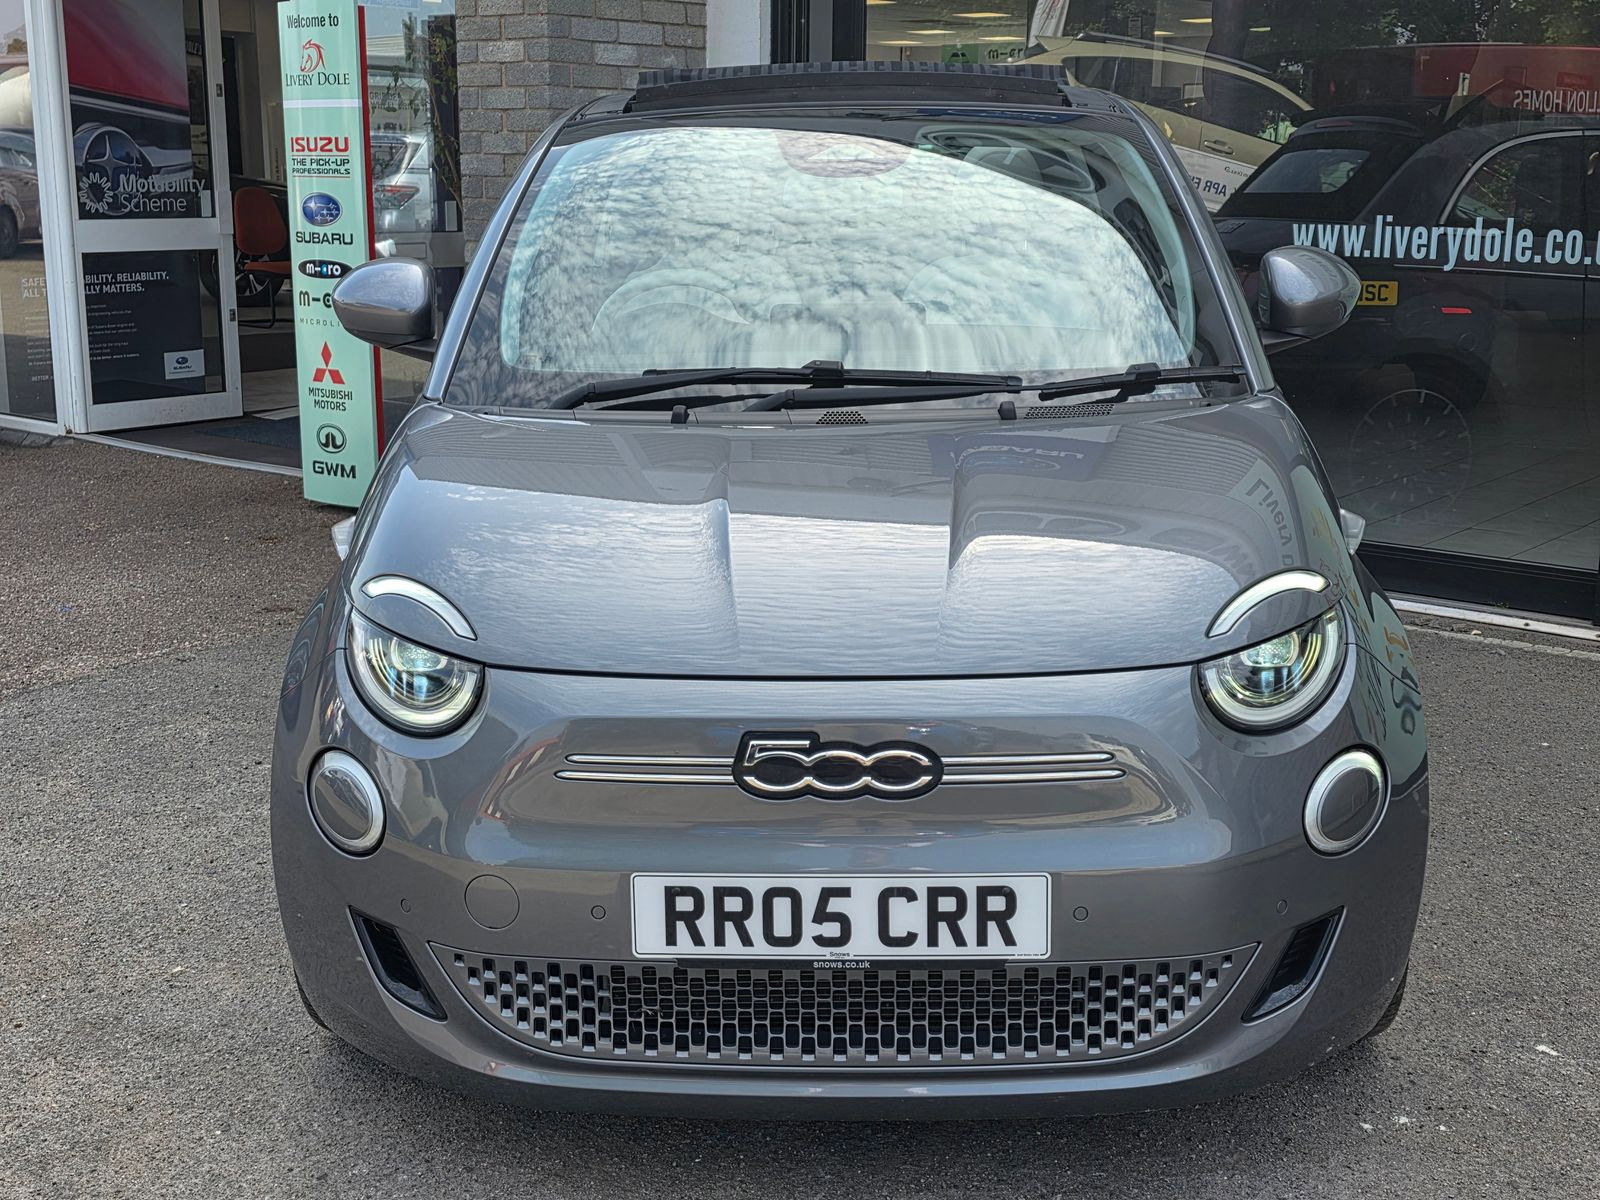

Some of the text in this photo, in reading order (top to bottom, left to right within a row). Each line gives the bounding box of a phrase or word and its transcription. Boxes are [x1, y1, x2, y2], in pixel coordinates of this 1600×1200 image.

[286, 13, 339, 28] Welcome to
[988, 48, 1023, 59] m-cr
[285, 72, 350, 87] LIVERY DOLE
[290, 136, 350, 153] ISUZU
[291, 158, 350, 167] THE PICK-UP
[291, 167, 351, 175] PROFESSIONALS
[120, 173, 206, 197] Motability
[121, 194, 187, 212] Scheme
[295, 231, 354, 245] SUBARU
[22, 271, 170, 287] SAFE BILITY. RELIABILITY.
[23, 288, 41, 298] ALL
[84, 284, 100, 295] LLY
[102, 283, 145, 294] MATTERS.
[299, 290, 333, 309] m-c
[300, 317, 340, 327] MICROLI
[308, 387, 353, 400] MITSUBISHI
[313, 398, 347, 411] MOTORS
[312, 460, 357, 478] GWM
[743, 741, 933, 792] 500
[664, 885, 1018, 948] RR05 CRR
[813, 961, 870, 969] snows.co.uk
